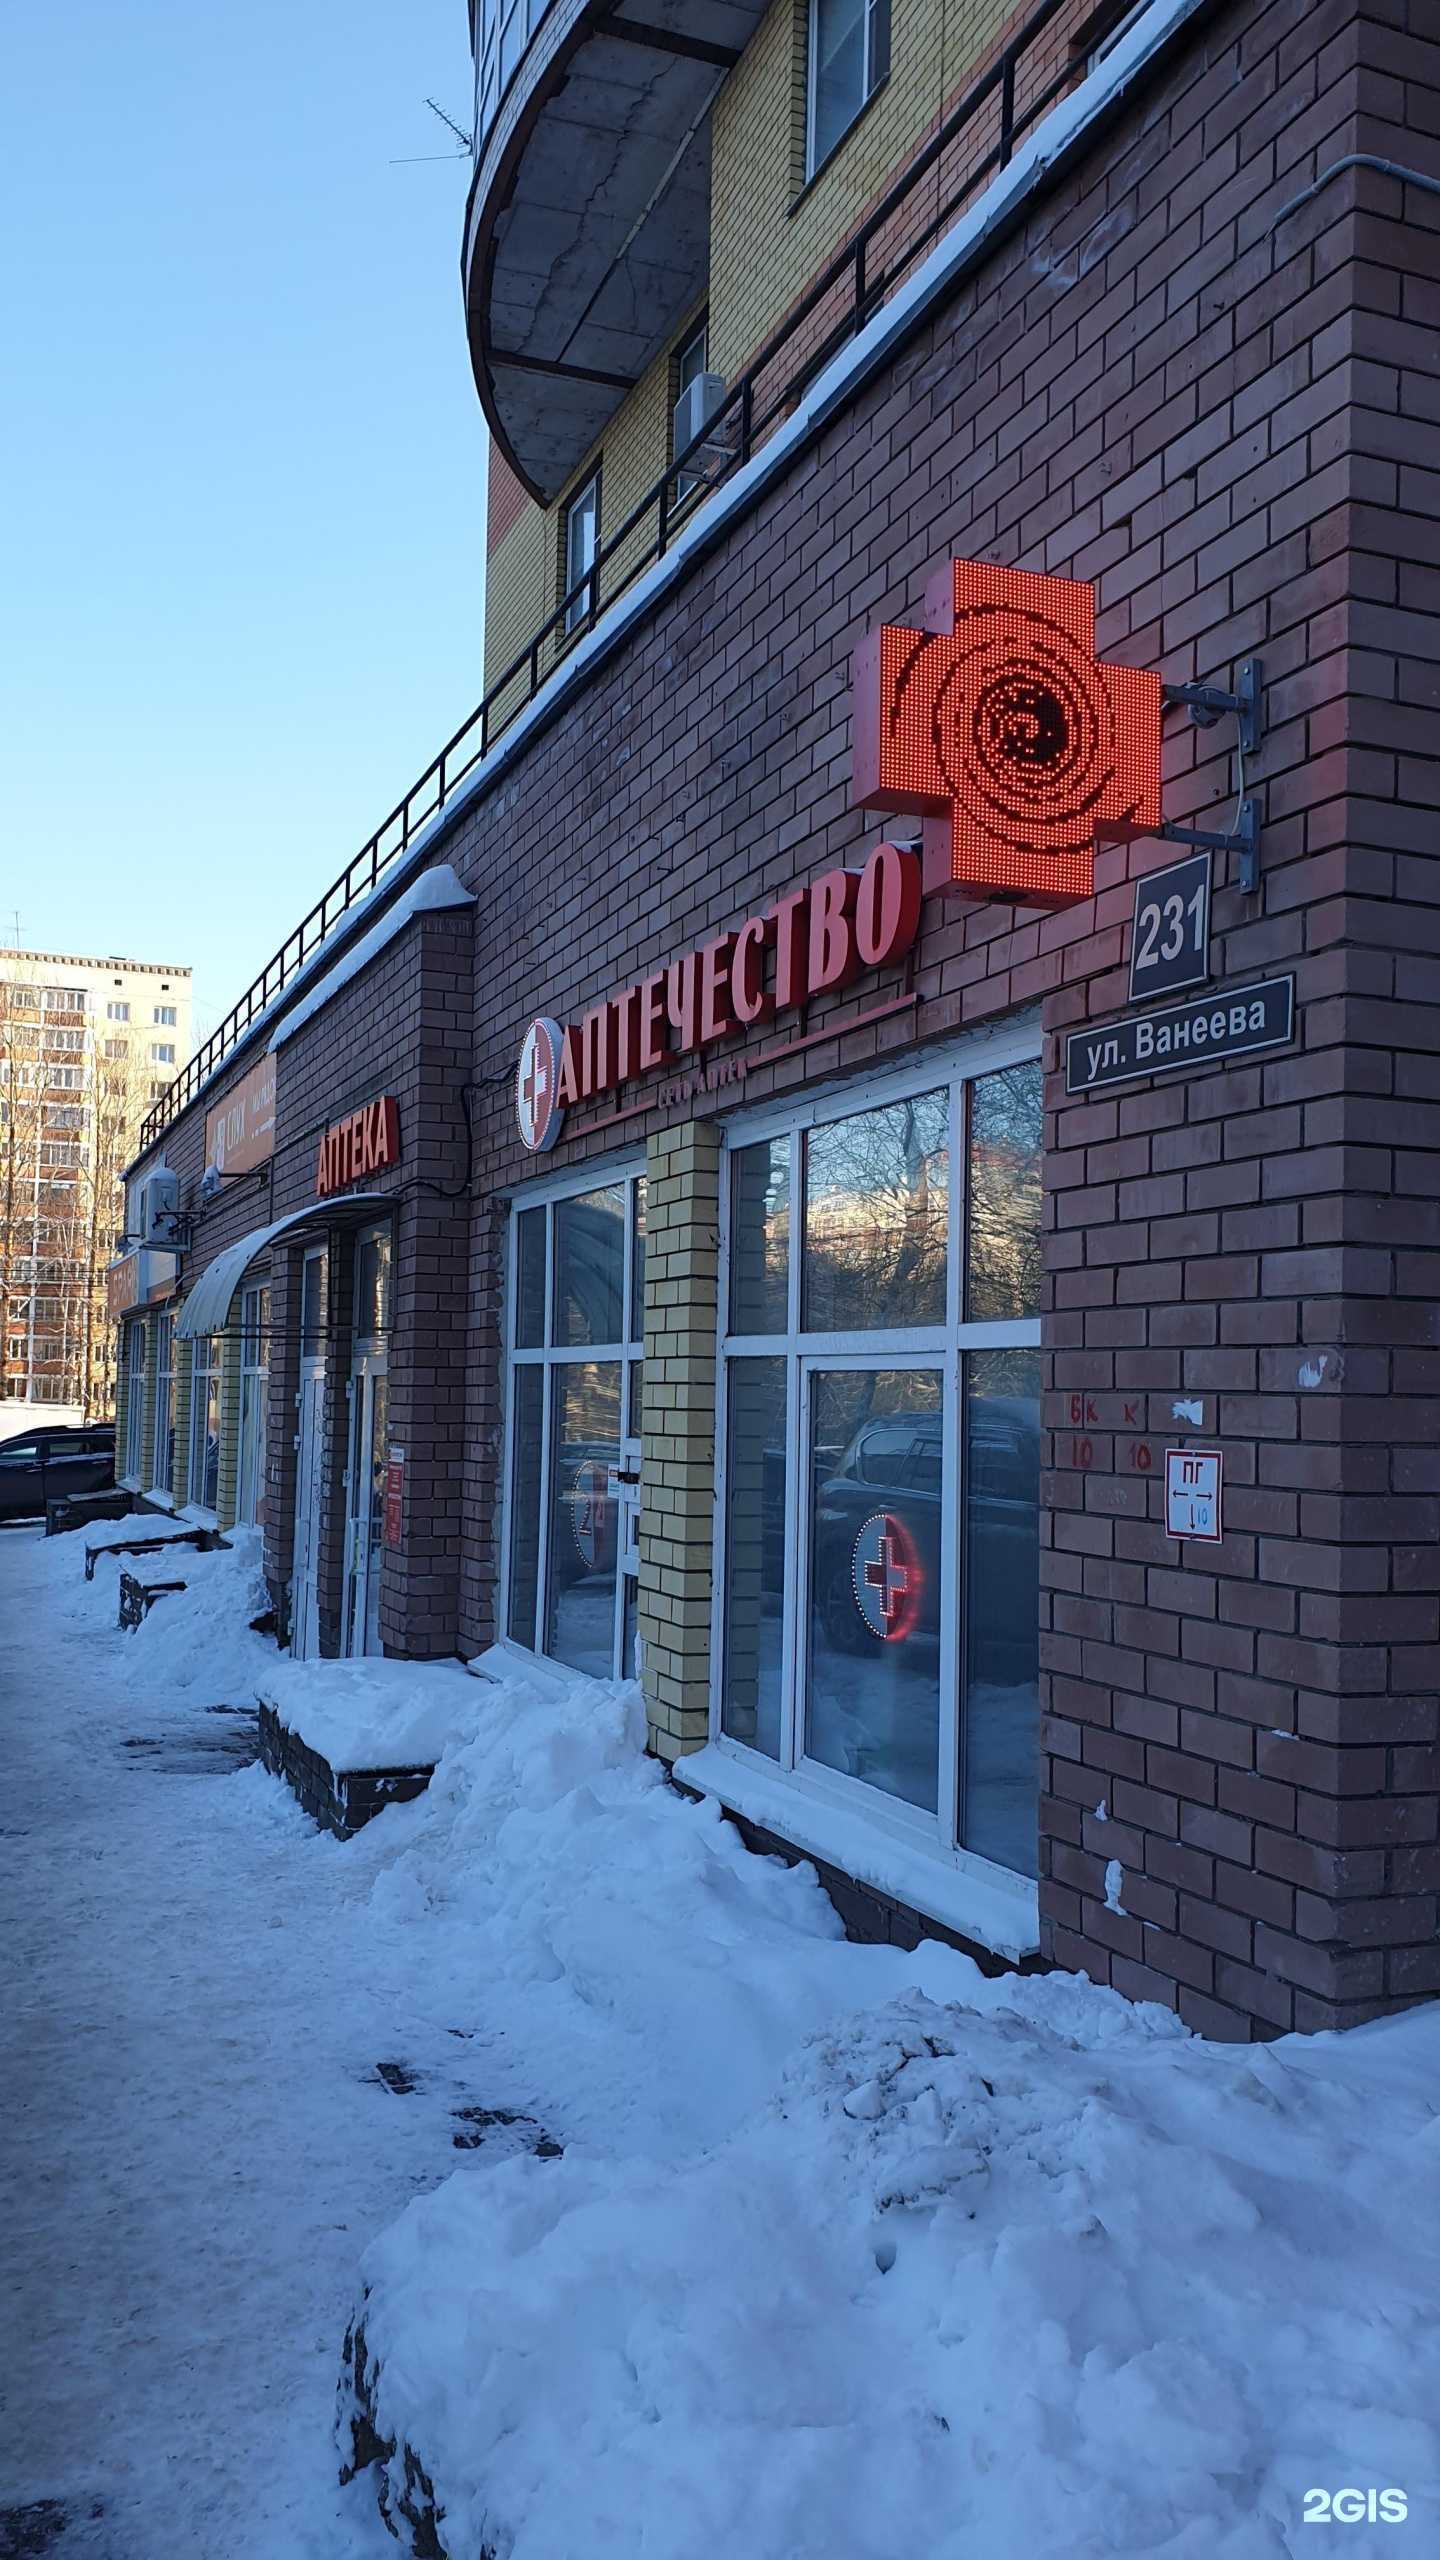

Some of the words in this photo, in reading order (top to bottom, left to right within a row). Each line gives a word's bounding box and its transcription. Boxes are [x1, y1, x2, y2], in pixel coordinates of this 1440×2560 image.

[1135, 884, 1205, 970] 231
[556, 842, 903, 1108] АПТЕЧЕСТВО
[1087, 1038, 1127, 1081] ул.
[1135, 1000, 1266, 1060] Ванеева
[316, 1096, 389, 1197] АПТЕКА
[1183, 1461, 1203, 1484] ПГ
